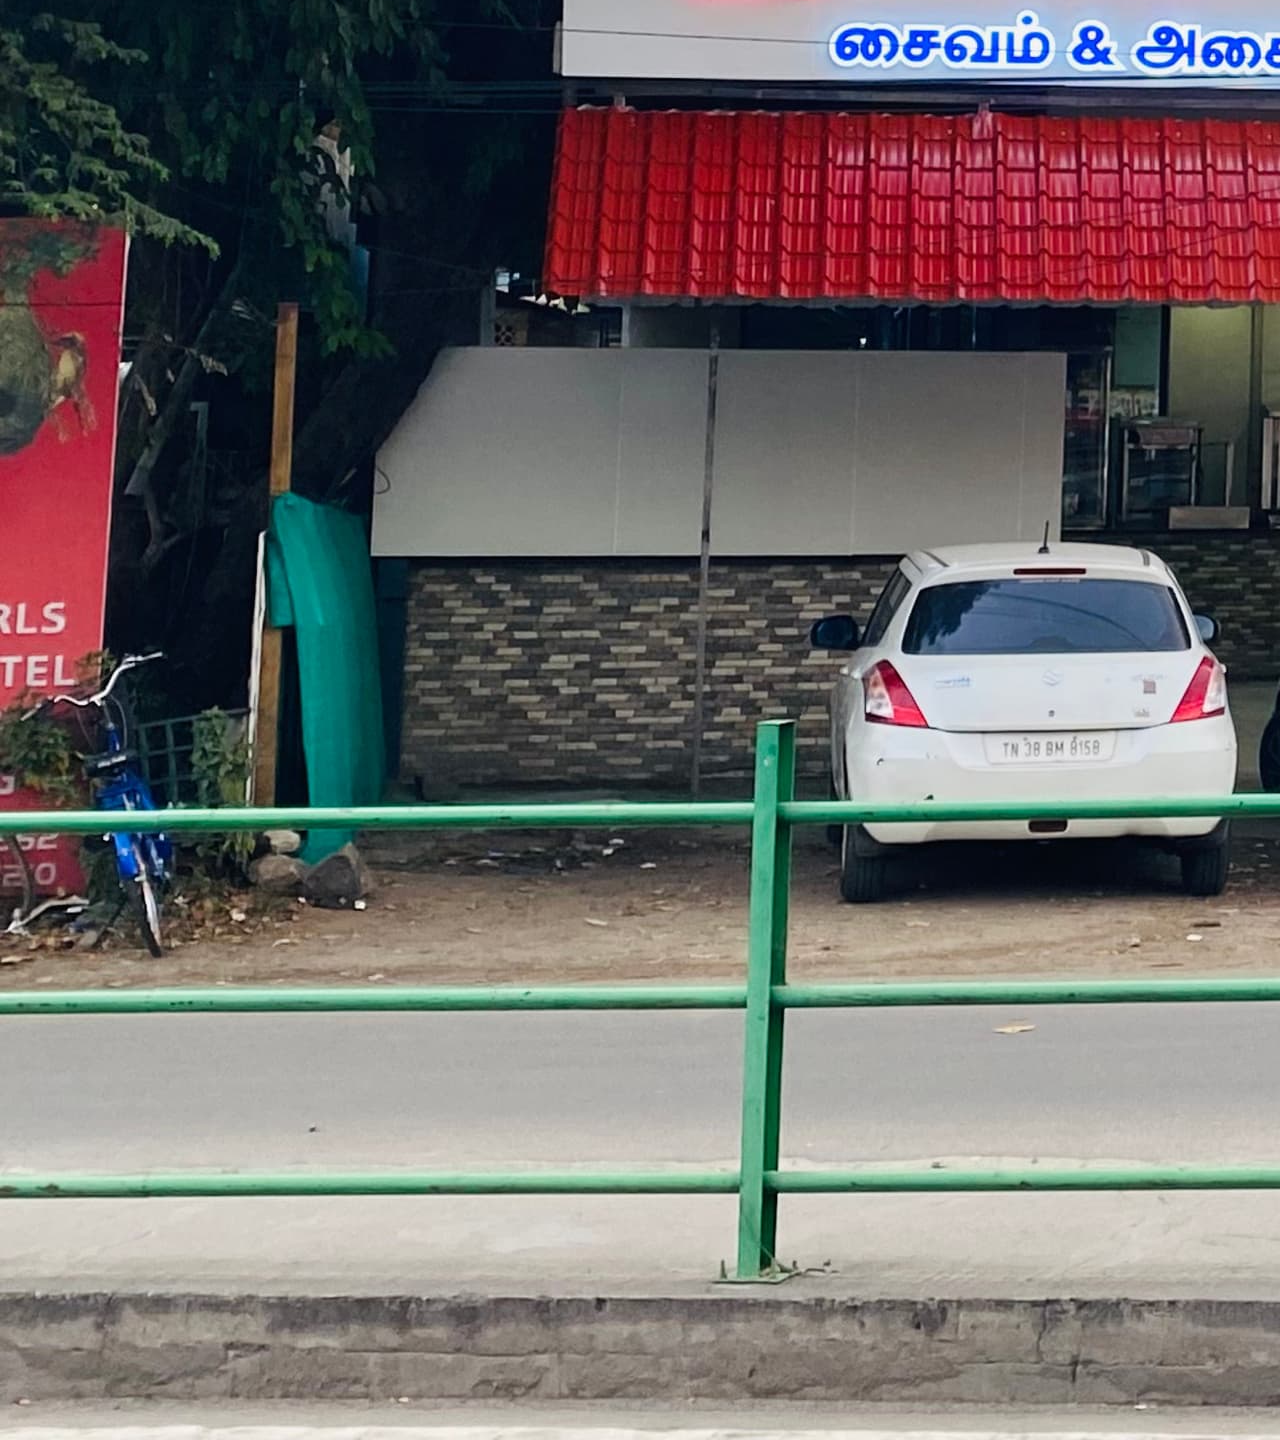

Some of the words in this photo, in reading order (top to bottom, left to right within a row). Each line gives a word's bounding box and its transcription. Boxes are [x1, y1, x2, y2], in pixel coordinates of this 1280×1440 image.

[834, 15, 1051, 63] சைவம்
[1072, 26, 1114, 65] &
[1003, 741, 1019, 758] TN
